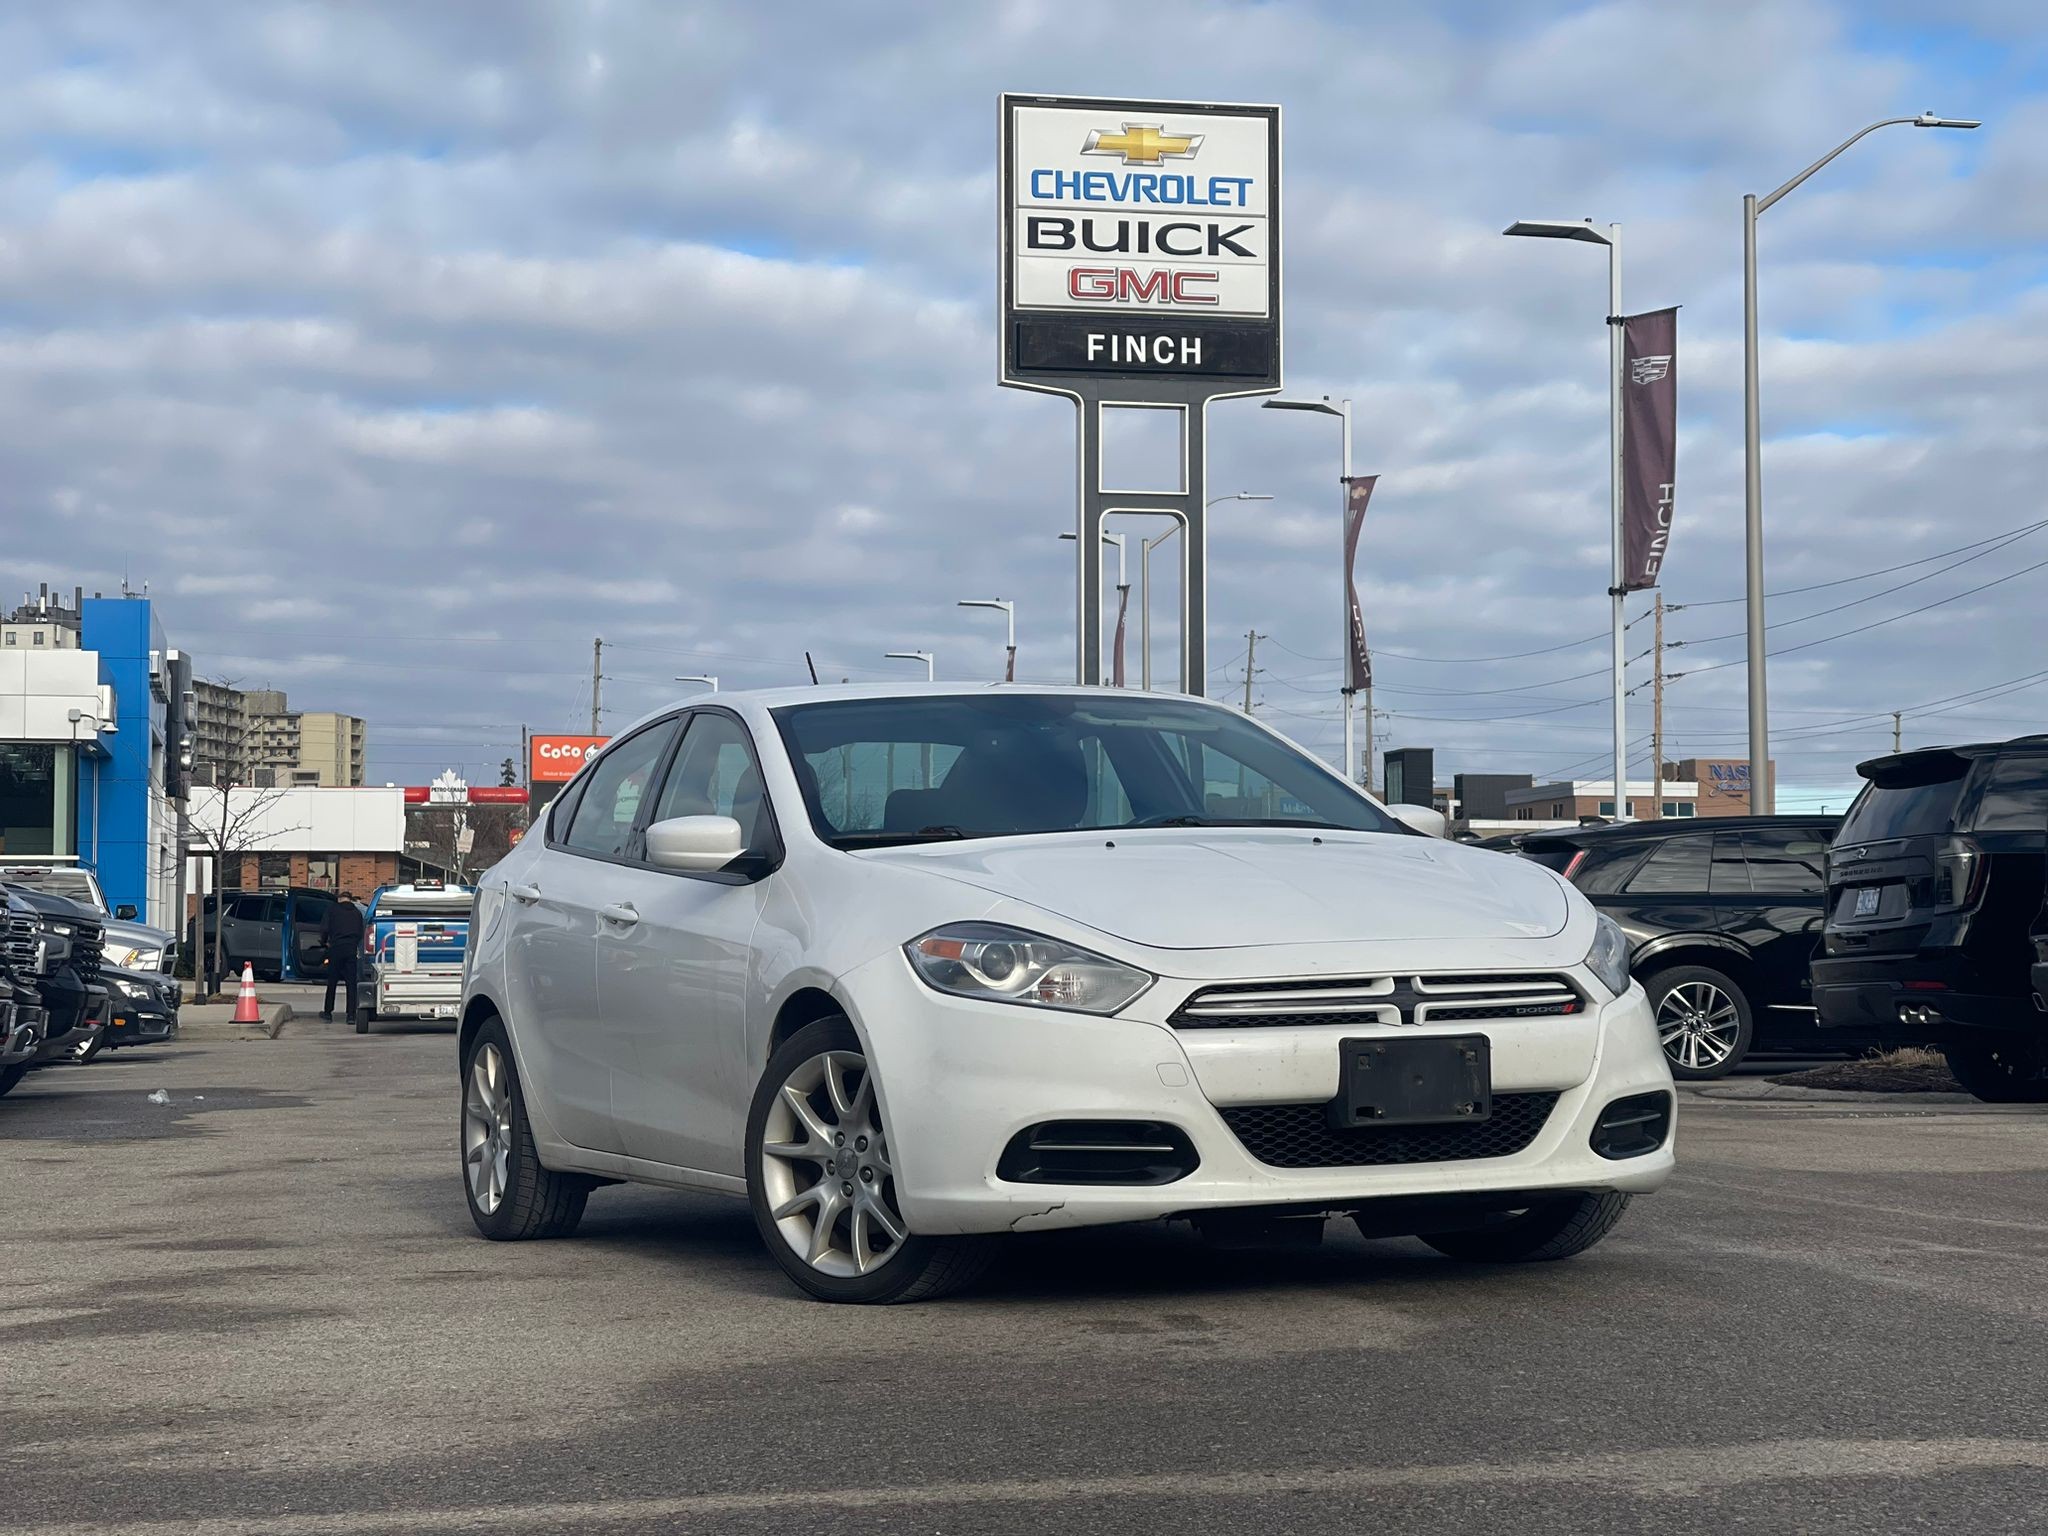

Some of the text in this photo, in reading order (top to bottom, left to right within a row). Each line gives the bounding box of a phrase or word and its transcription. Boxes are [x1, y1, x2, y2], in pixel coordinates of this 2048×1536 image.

[1031, 169, 1253, 207] CHEVROLET
[1027, 216, 1257, 258] BUICK
[1067, 265, 1220, 305] GMC
[1087, 333, 1202, 365] FINCH
[1645, 483, 1674, 576] FINCH
[1708, 764, 1751, 781] NAS
[1516, 1006, 1564, 1014] DODGE
